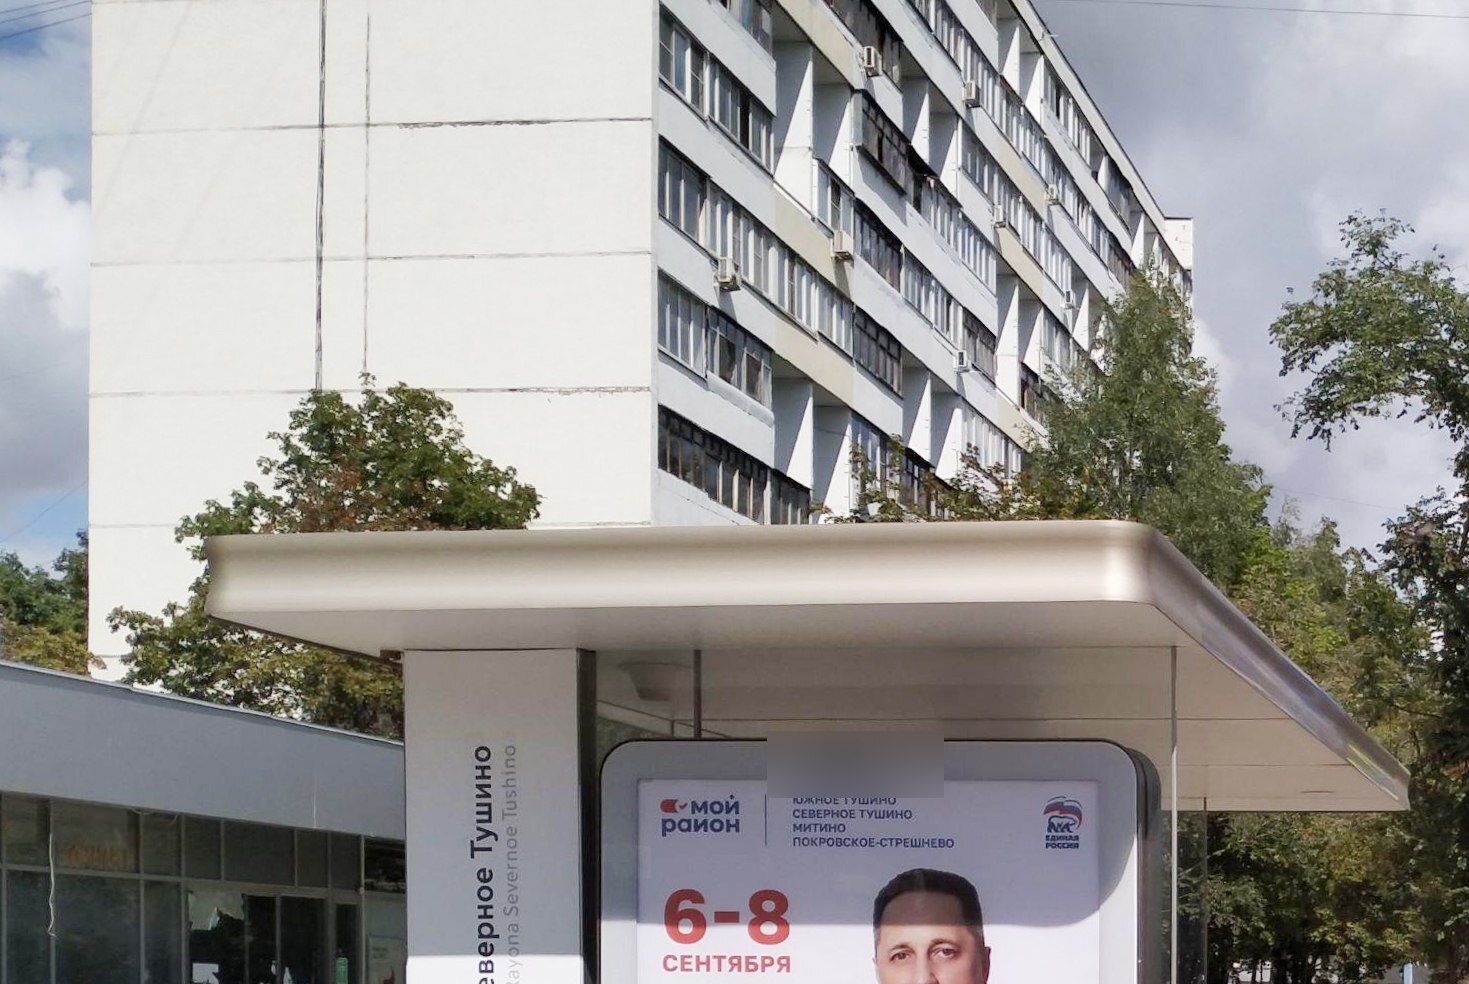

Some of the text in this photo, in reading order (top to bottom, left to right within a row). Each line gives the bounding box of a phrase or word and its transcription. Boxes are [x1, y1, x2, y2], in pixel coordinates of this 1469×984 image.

[502, 744, 516, 821] Tushino
[470, 745, 499, 859] Тушино
[792, 809, 913, 820] СЕВЕРНОЕ ТУШИНО
[792, 823, 846, 833] МИТИНО
[792, 837, 954, 848] ПОКРОВСКОЕ-СТРЕШНЕВО
[503, 826, 518, 916] Severnoe
[662, 954, 791, 973] СЕНТЯБРЯ
